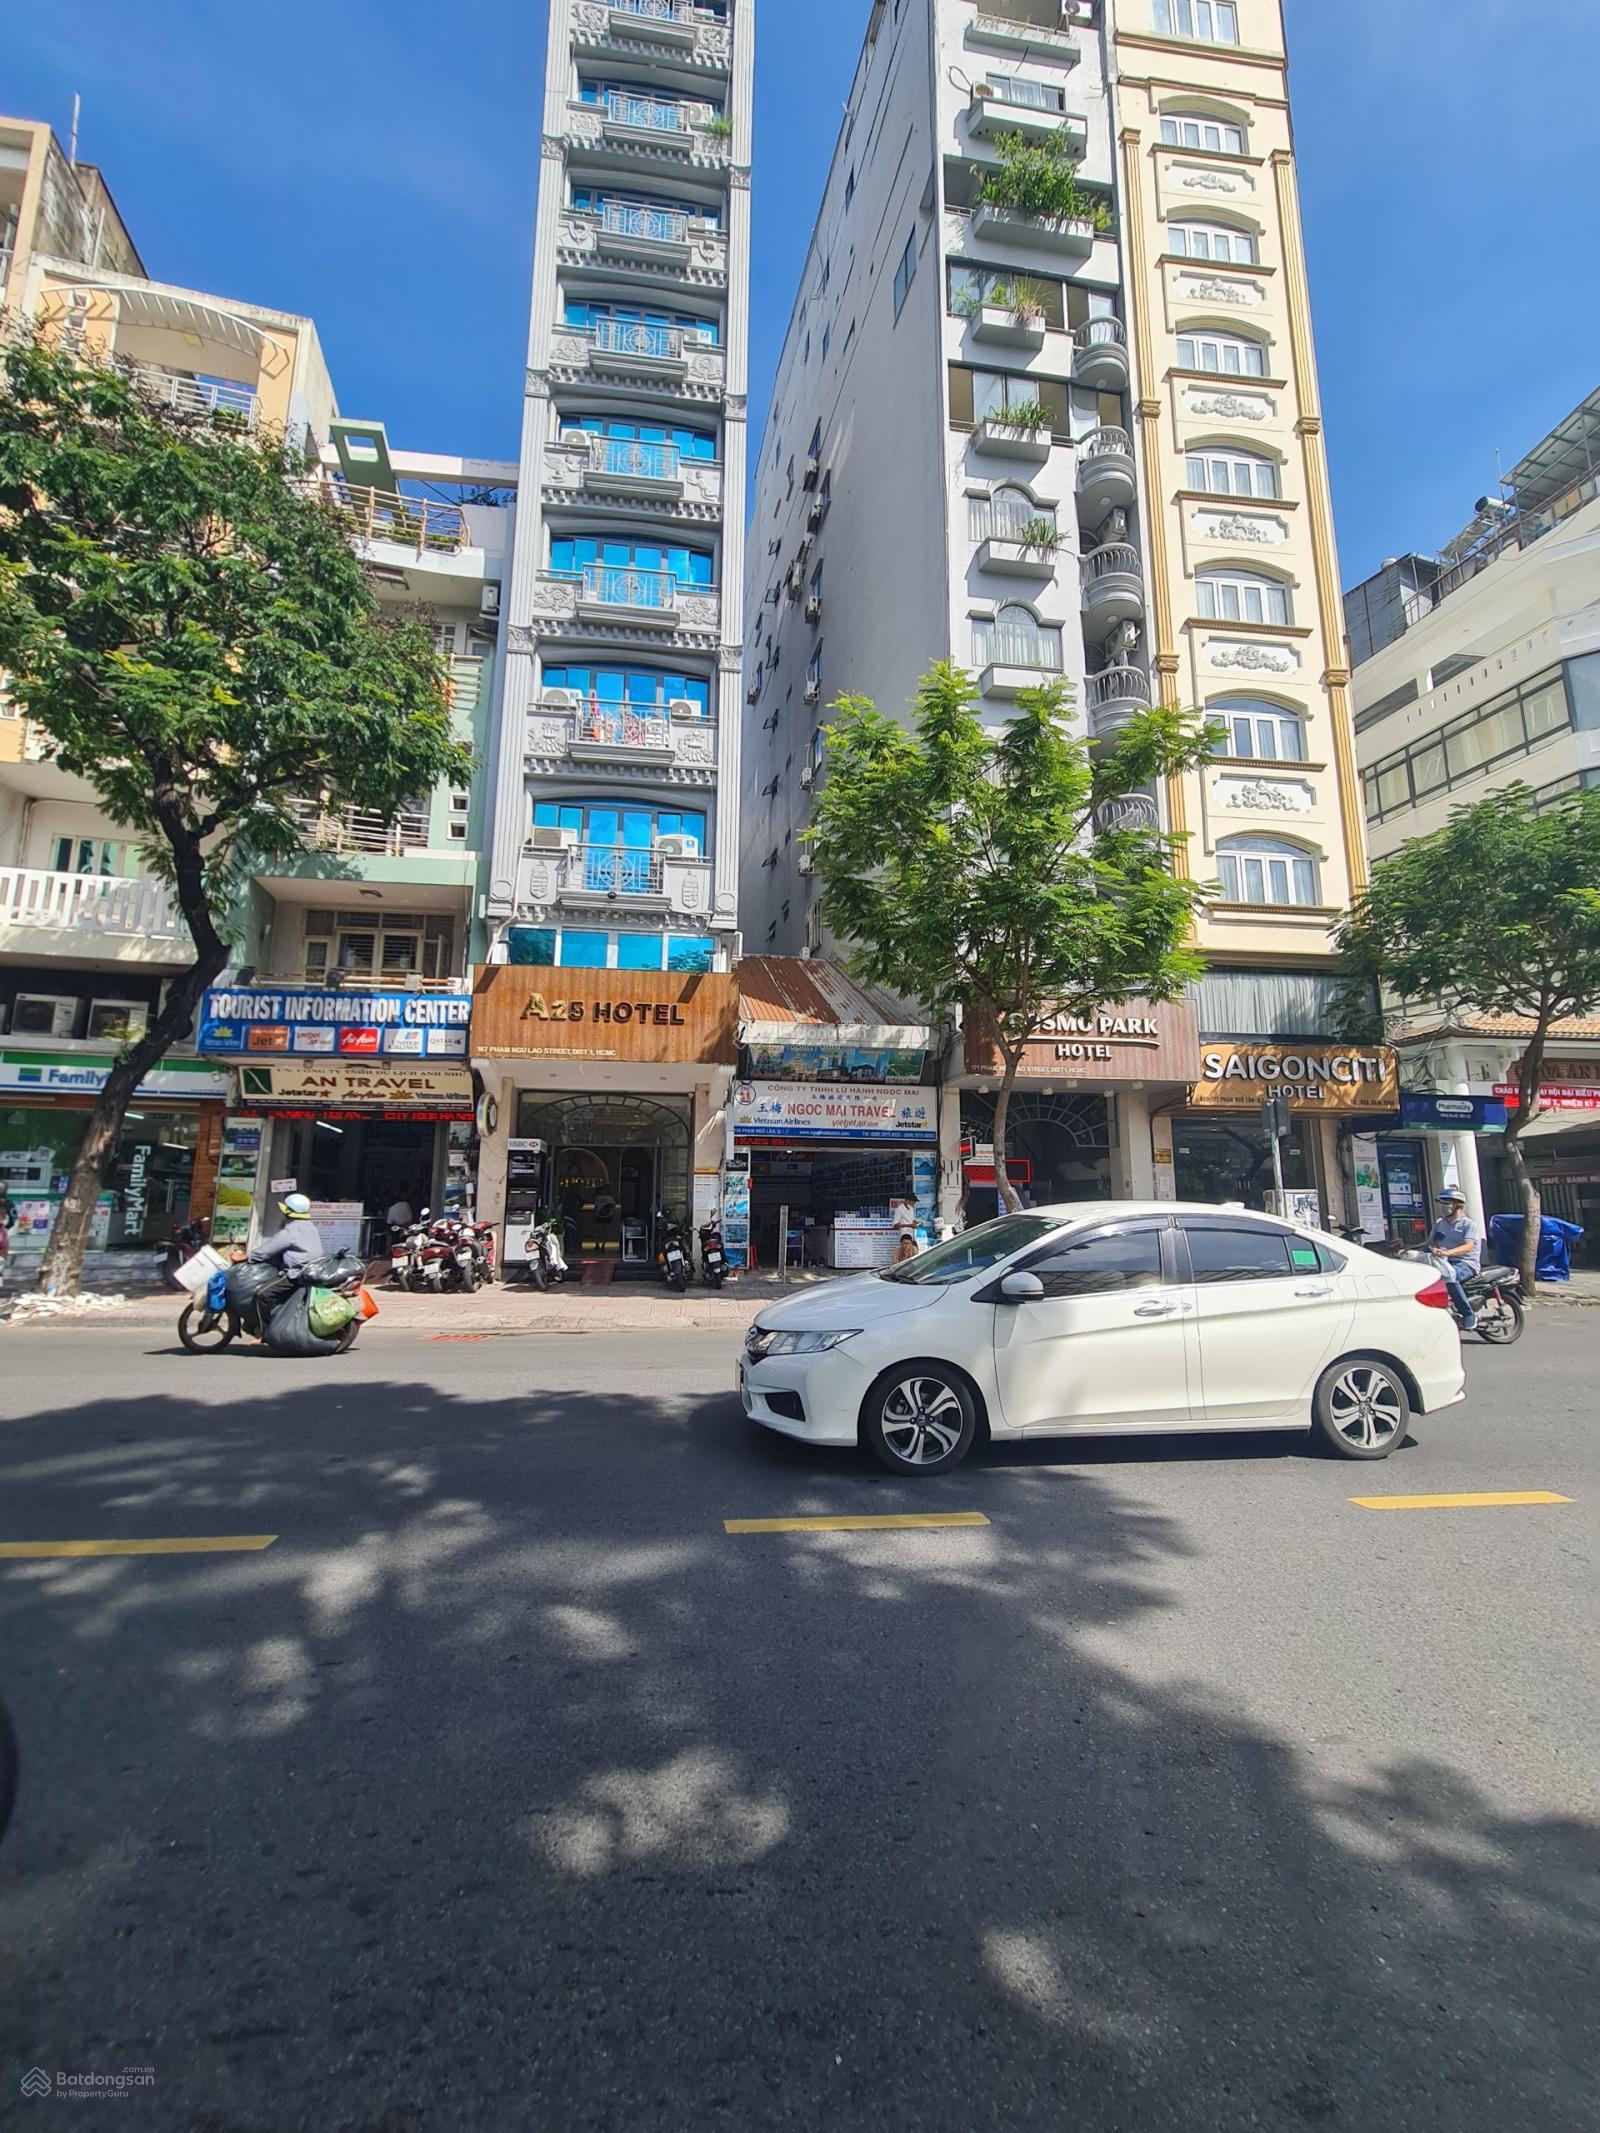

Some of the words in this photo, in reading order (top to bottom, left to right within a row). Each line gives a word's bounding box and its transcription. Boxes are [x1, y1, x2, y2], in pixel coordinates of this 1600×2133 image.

[209, 993, 282, 1020] TOURIST
[285, 996, 399, 1022] INFORMATION
[404, 999, 469, 1024] CENTER
[520, 992, 584, 1022] A25
[592, 1001, 684, 1026] HOTEL
[1100, 1017, 1159, 1036] PARK
[1057, 1043, 1113, 1061] HOTEL
[1204, 1053, 1387, 1083] SAIGONCITI
[301, 1077, 337, 1087] AN
[345, 1077, 435, 1089] TRAVEL
[768, 1084, 793, 1092] CÔNG
[1268, 1085, 1326, 1099] HOTEL
[826, 1104, 846, 1117] MAI
[850, 1105, 896, 1118] TRAVEL
[753, 1117, 783, 1125] Vietnam
[784, 1117, 811, 1125] Airlines
[124, 1145, 150, 1235] FamilyMart
